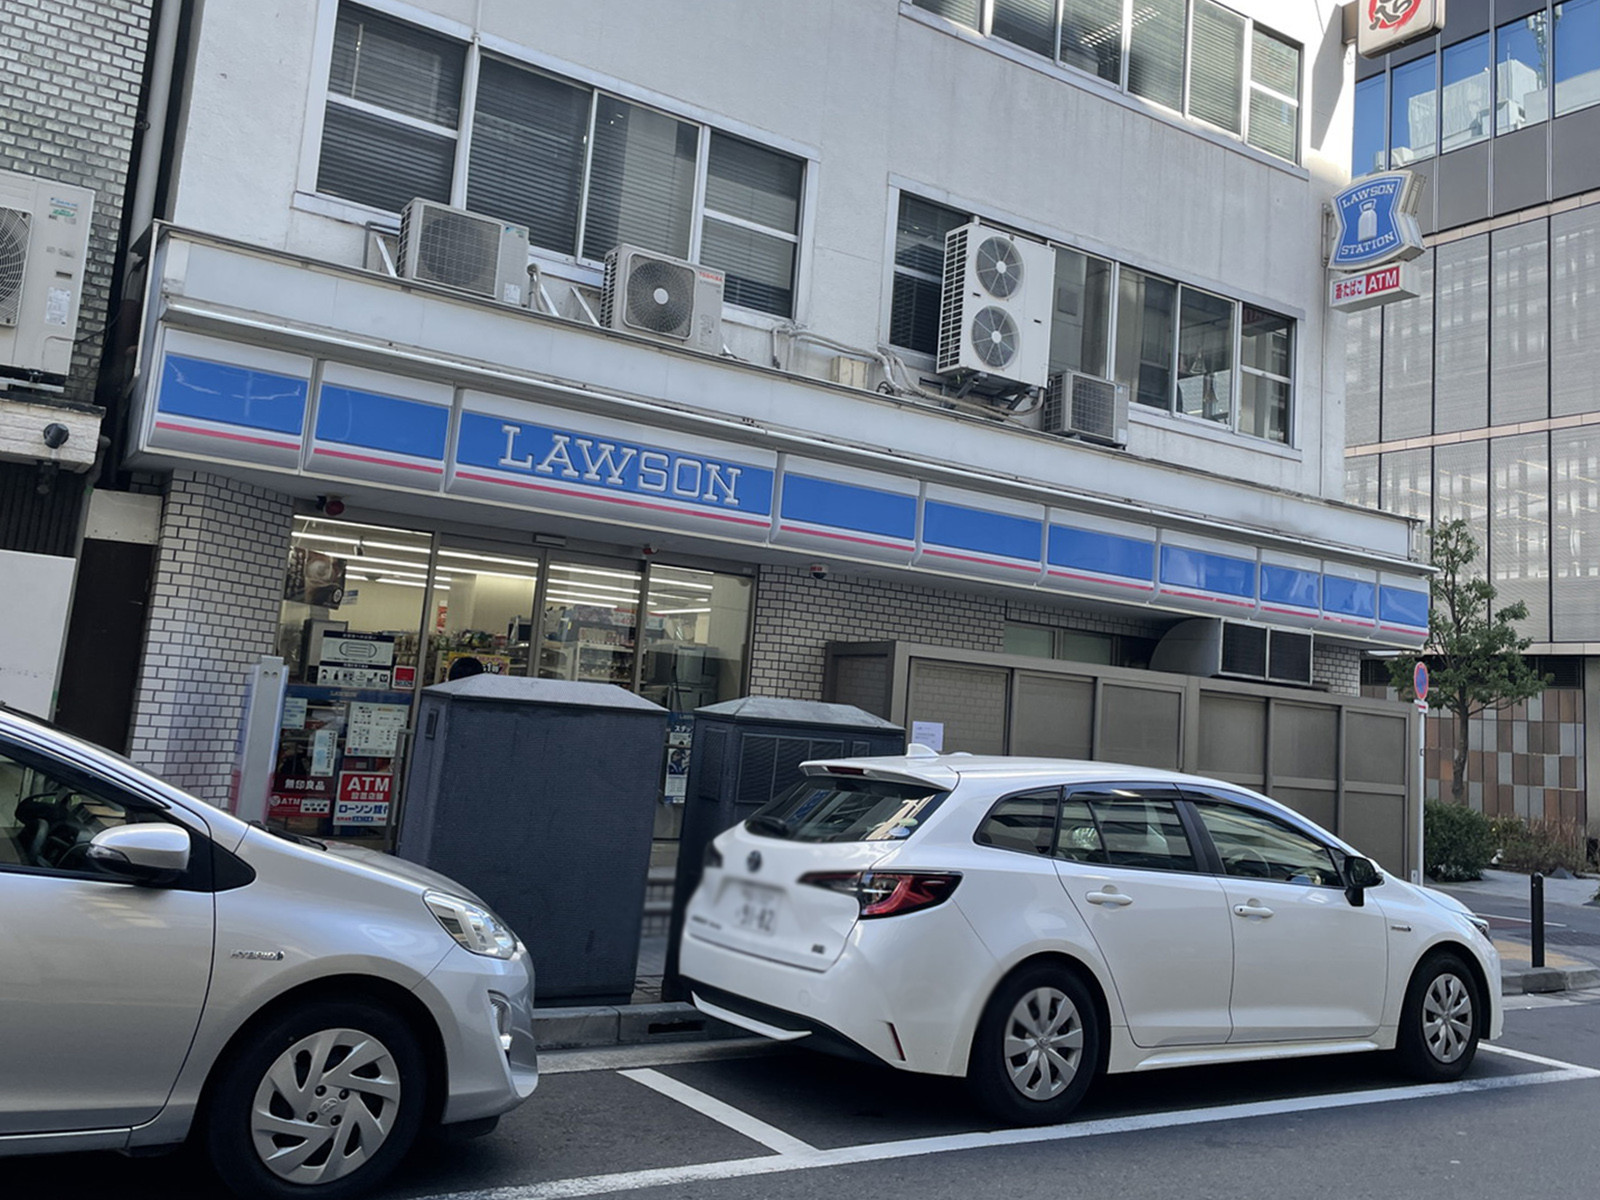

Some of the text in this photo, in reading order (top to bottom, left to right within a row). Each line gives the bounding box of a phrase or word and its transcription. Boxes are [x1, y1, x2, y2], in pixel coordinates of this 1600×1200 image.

[1342, 183, 1395, 208] LAWSON
[1341, 231, 1394, 256] STATION
[1368, 270, 1397, 292] ATM
[499, 425, 742, 506] LAWSON
[284, 778, 325, 791] 無印良品
[347, 777, 390, 791] ATM
[281, 797, 300, 805] ATM
